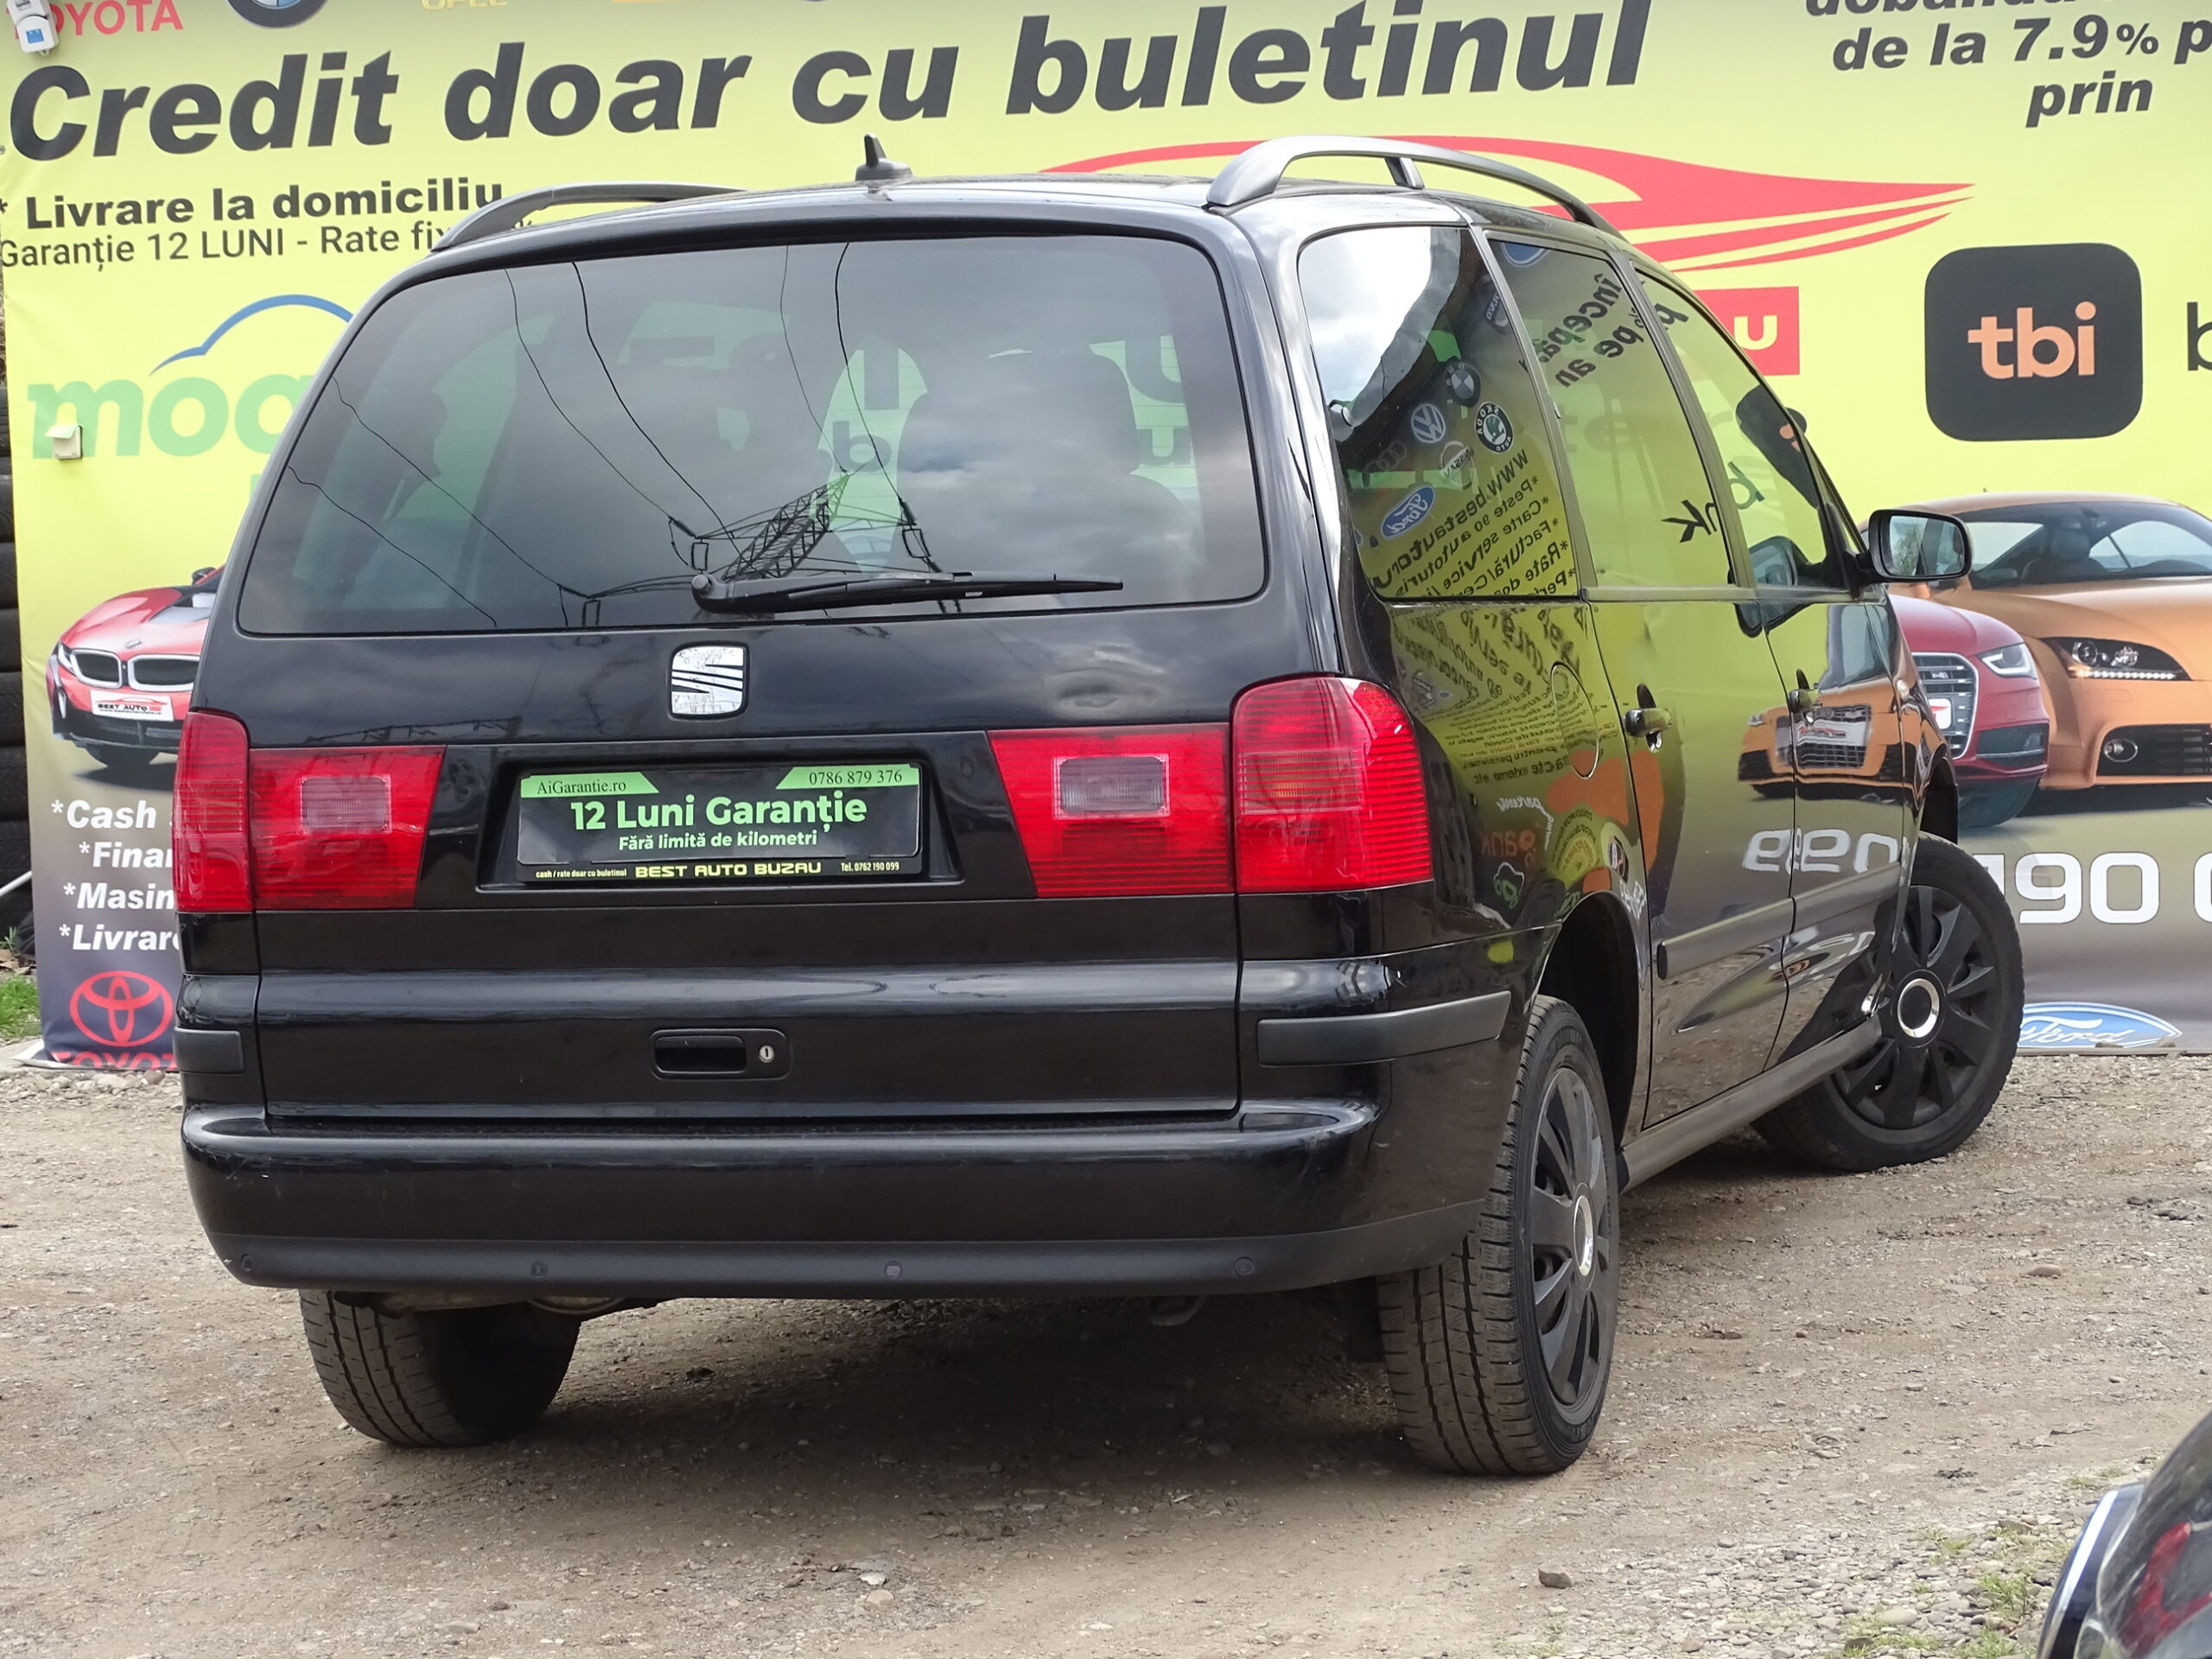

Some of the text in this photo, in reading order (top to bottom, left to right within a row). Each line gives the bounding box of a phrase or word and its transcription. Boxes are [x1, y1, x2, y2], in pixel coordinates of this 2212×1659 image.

[7, 0, 183, 39] YOTA
[1833, 27, 1908, 71] de
[1929, 22, 1986, 66] la
[10, 0, 1649, 161] Credit doar cu buletinul
[2025, 70, 2153, 128] prin
[26, 176, 502, 229] Livrare la domiciliu
[0, 234, 135, 271] Garanție
[148, 232, 189, 260] 12
[201, 228, 283, 259] LUNI
[321, 225, 399, 254] Rate
[1967, 301, 2097, 379] tbi
[537, 779, 627, 795] AiGarantie.ro
[809, 769, 903, 785] 0786 879 376
[570, 790, 868, 833] 12 Luni Garanție
[619, 830, 818, 851] Fără limită de kilometri
[536, 870, 552, 879] cash
[571, 869, 587, 878] doar
[596, 868, 627, 877] buletinul
[635, 862, 822, 878] BEST AUTO BUZAU
[841, 861, 899, 872] Tel. 0762 190 099
